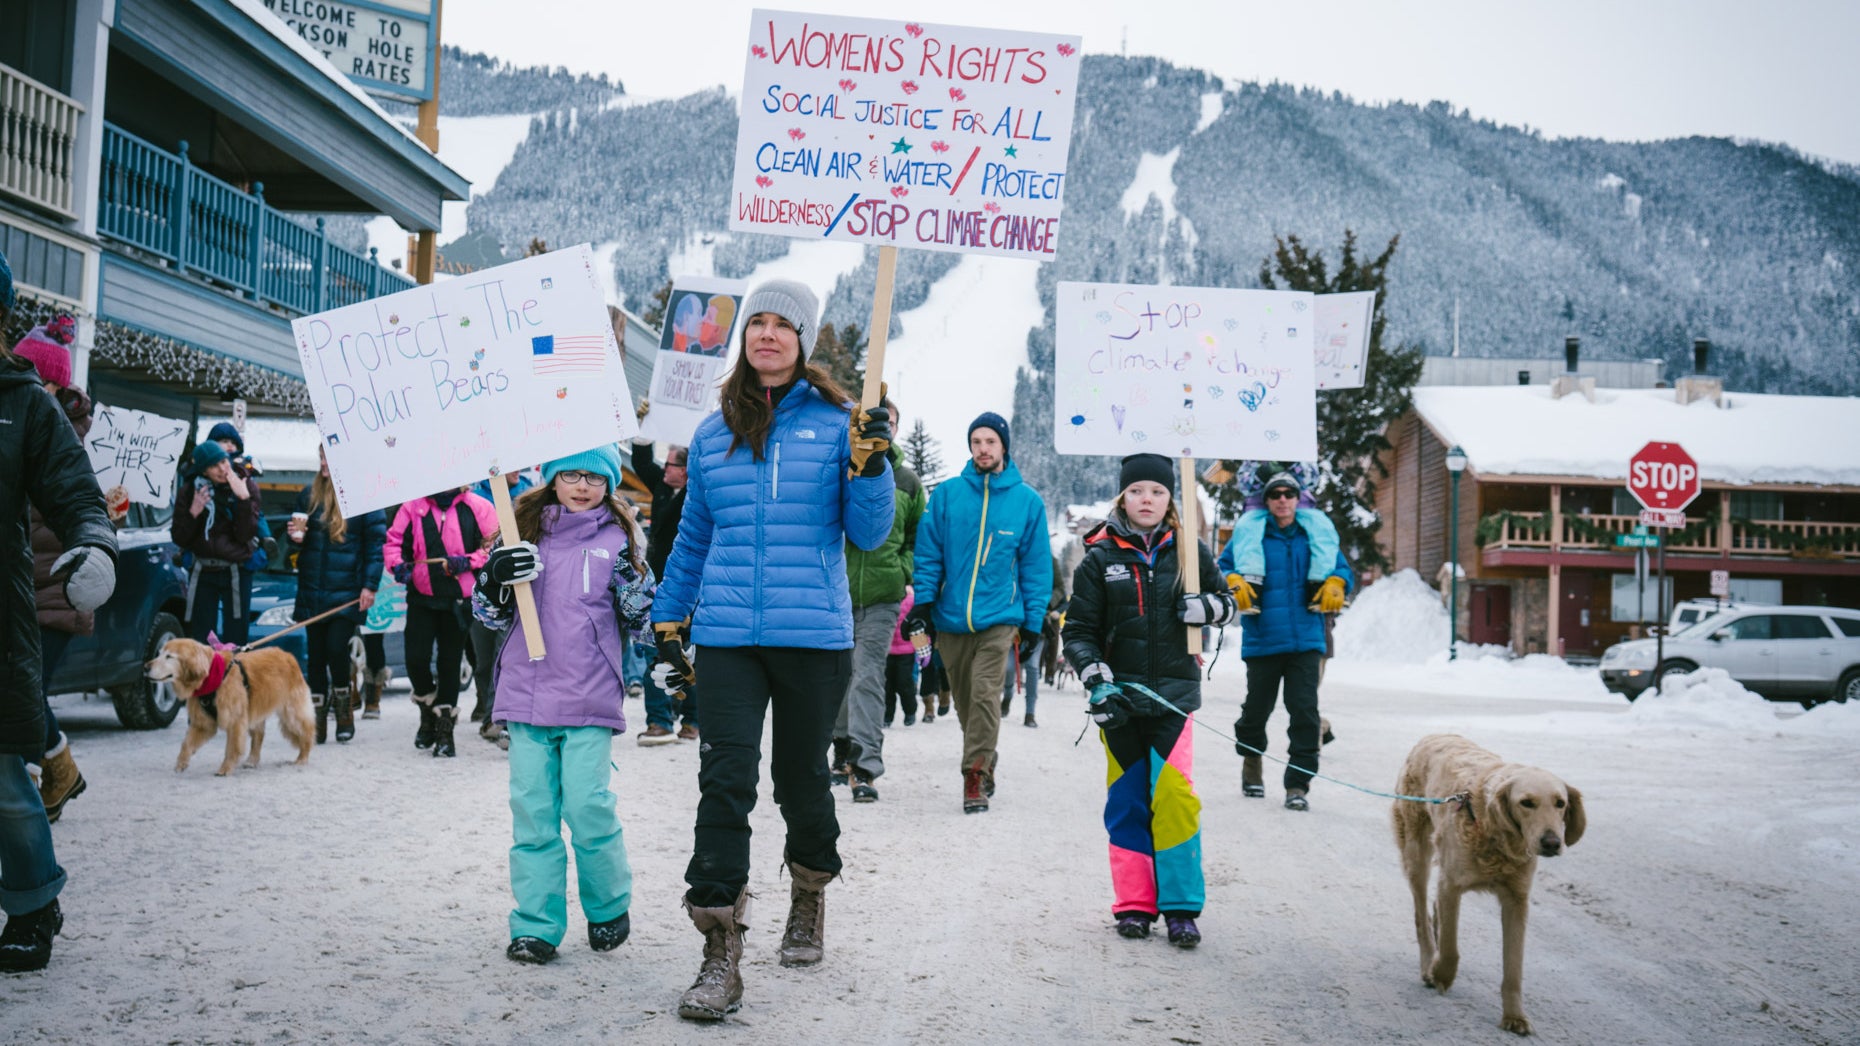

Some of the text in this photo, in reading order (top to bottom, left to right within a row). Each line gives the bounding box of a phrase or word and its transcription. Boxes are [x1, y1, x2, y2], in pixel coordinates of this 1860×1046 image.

[379, 19, 402, 38] TO
[369, 38, 414, 64] HOLE
[768, 20, 1047, 85] WOMEN'S RIGHTS
[353, 57, 411, 86] RATES
[762, 84, 1051, 141] SOCIAL JUSTICE FOR ALL
[756, 142, 821, 178] CLEAN
[826, 152, 862, 181] AIR
[981, 162, 1065, 200] PROTECT
[916, 209, 986, 248] CLIMATE
[989, 216, 1059, 254] CHANGE
[309, 279, 544, 386] Protect The
[331, 359, 509, 442] Polar Bears
[108, 426, 161, 451] I'M WITH
[114, 449, 153, 473] HER
[1632, 460, 1696, 491] STOP
